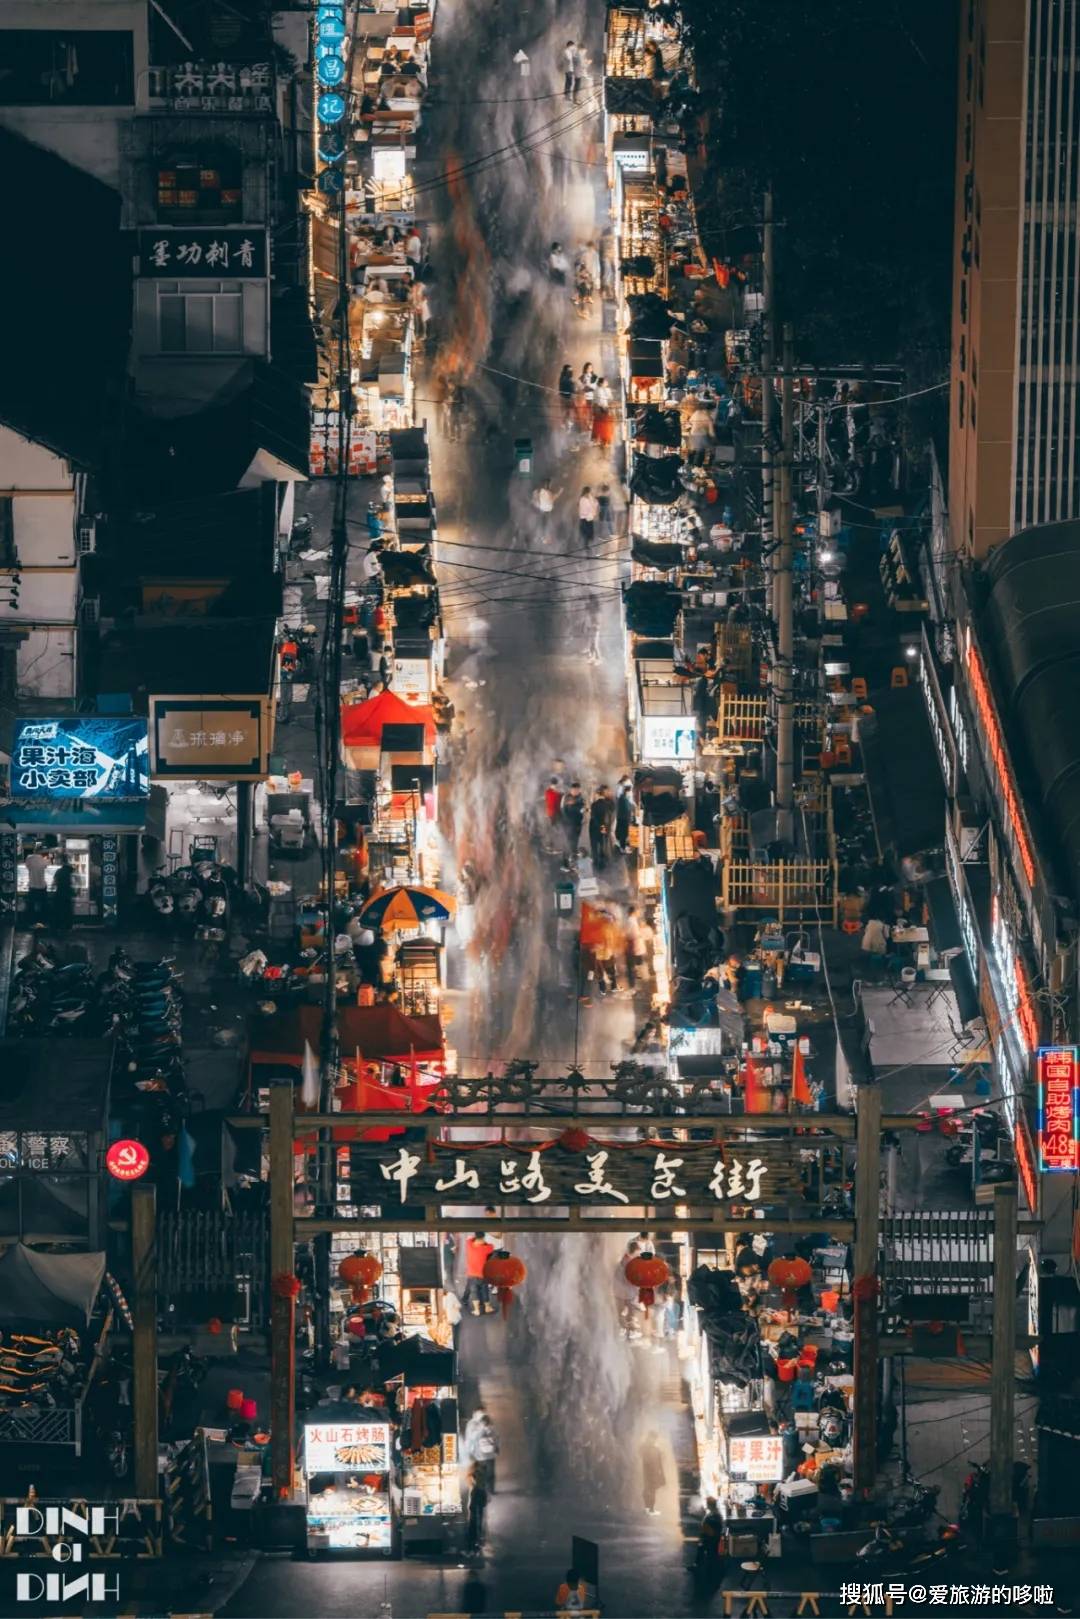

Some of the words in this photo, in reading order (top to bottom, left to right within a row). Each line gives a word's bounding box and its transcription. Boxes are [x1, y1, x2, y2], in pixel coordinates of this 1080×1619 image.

[148, 238, 256, 268] 墨功刺青
[19, 746, 97, 767] 果汁海
[20, 768, 98, 789] 小卖部
[1044, 1051, 1073, 1132] 韩国自助烤肉
[28, 1136, 69, 1157] 警察
[1046, 1134, 1068, 1154] 48
[379, 1148, 769, 1204] 中山路美食街
[310, 1426, 385, 1442] 火山石烤肠
